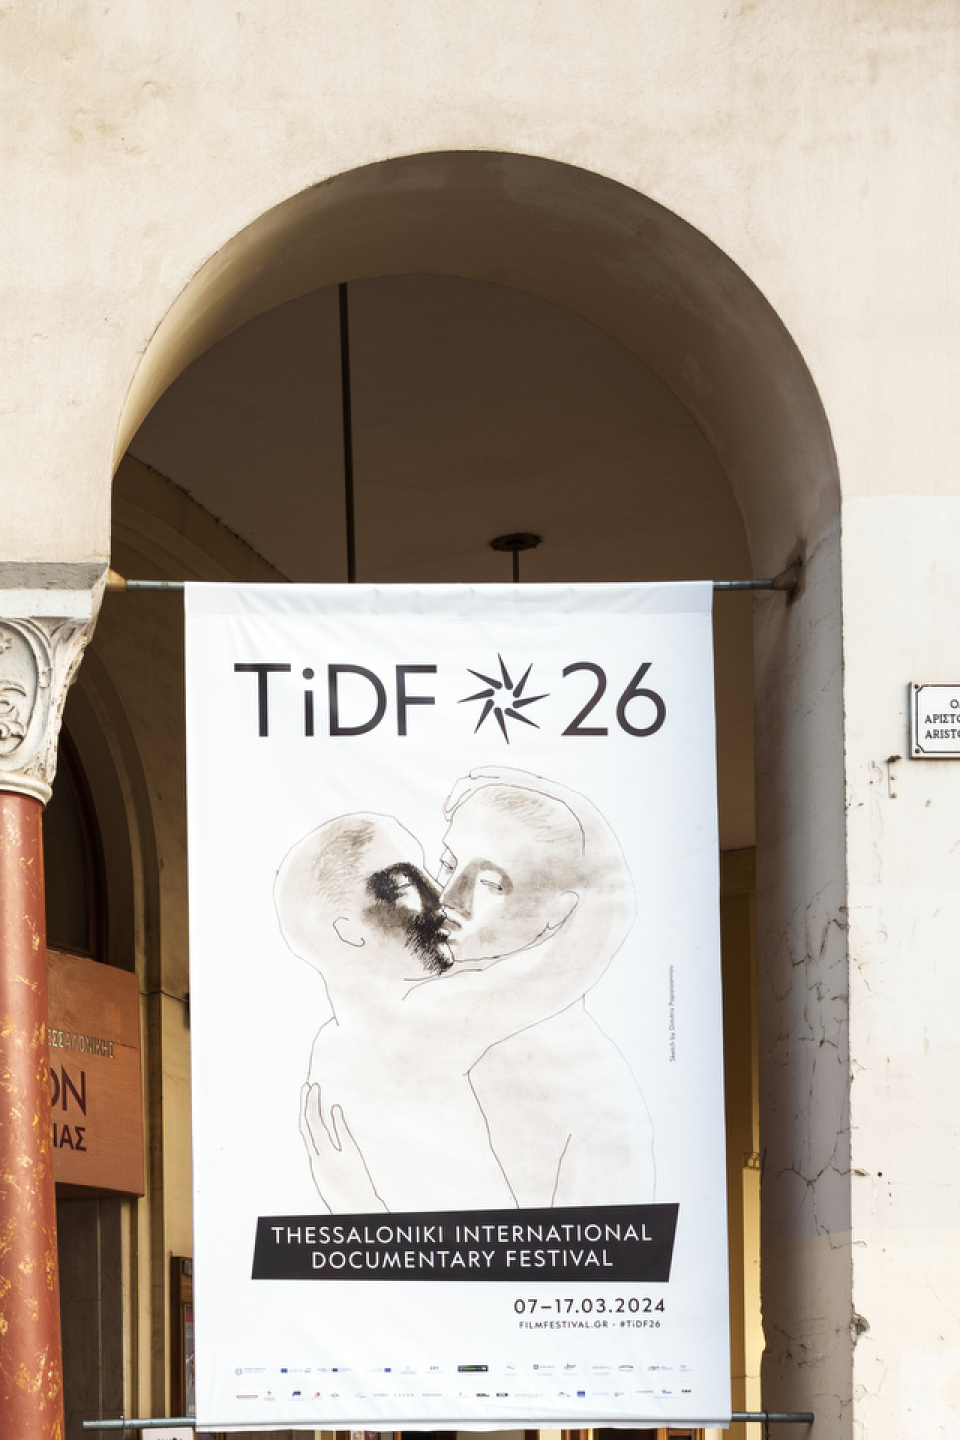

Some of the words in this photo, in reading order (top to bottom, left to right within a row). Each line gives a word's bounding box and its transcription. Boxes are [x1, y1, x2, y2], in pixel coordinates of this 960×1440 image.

[233, 662, 438, 738] TiDF
[560, 660, 667, 738] 26
[47, 1028, 115, 1059] ΕΣΣΑΛΟΝΙΚΗΣ
[271, 1225, 443, 1245] THESSALONIKI
[454, 1222, 653, 1244] INTERNATIONAL
[311, 1249, 496, 1270] DOCUMENTARY
[506, 1248, 613, 1269] FESTIVAL
[518, 1320, 609, 1330] FILMFESTIVAL.GR
[620, 1319, 661, 1329] #TiDF26
